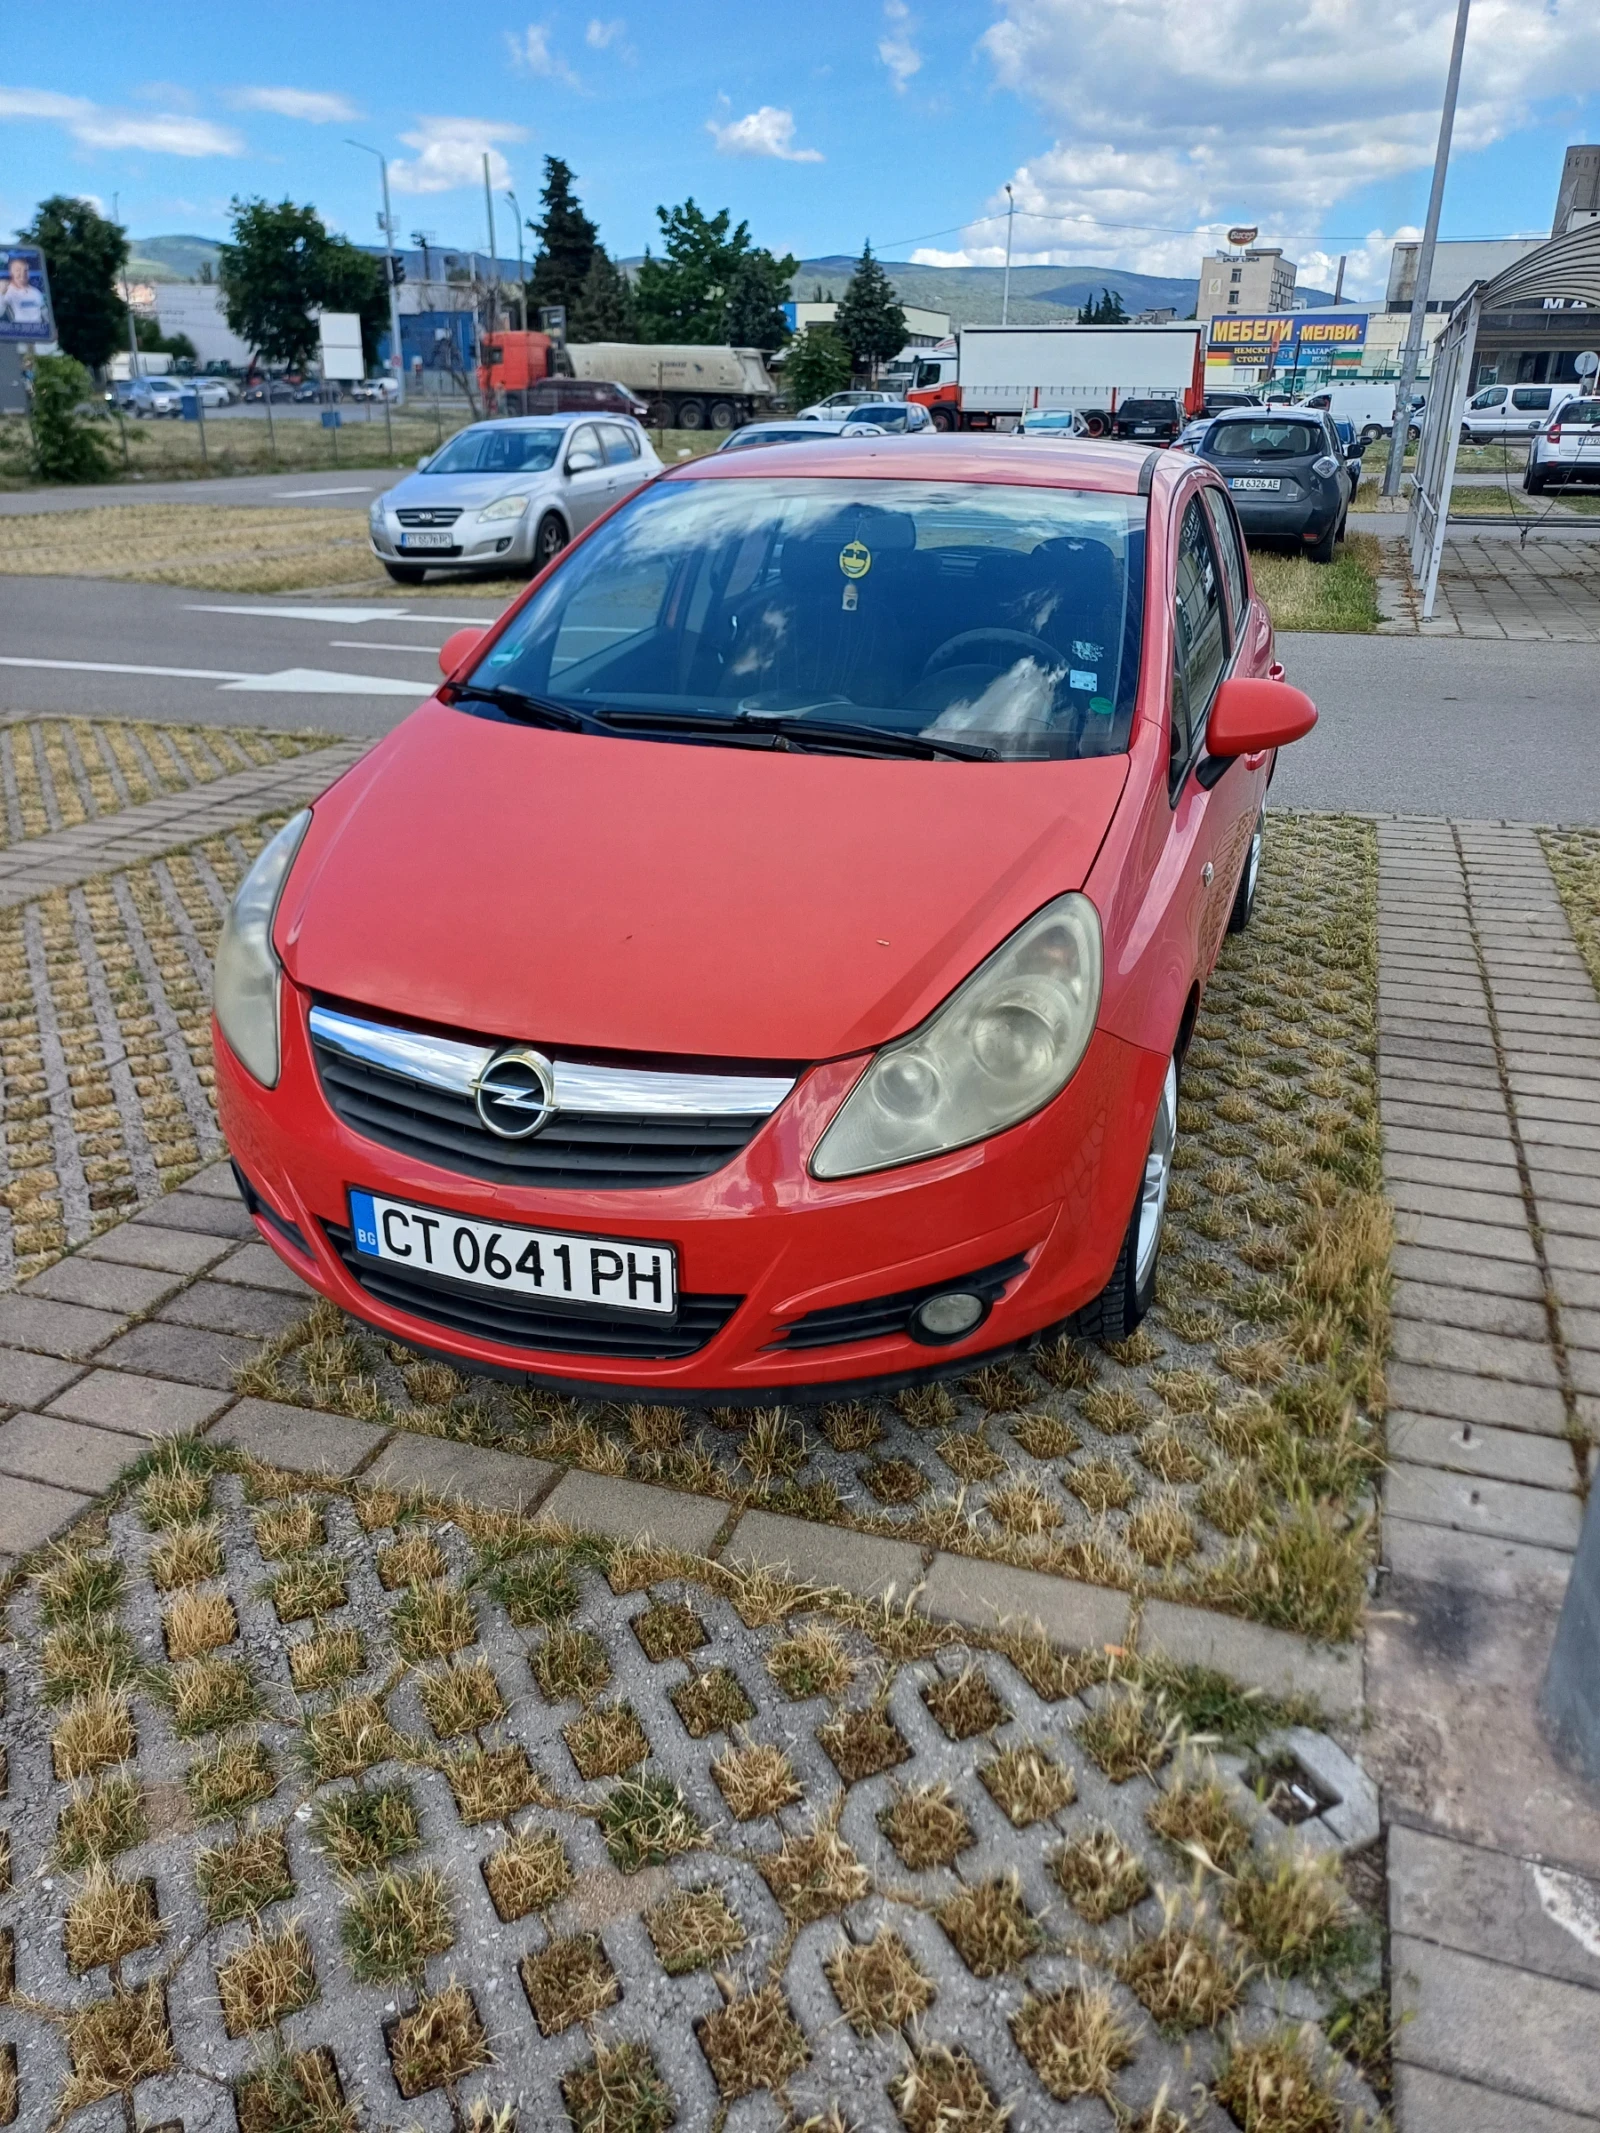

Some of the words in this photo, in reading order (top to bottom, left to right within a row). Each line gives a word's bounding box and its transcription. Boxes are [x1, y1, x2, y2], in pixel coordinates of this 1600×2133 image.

[1212, 319, 1294, 342] МЕБЕЛИ
[1301, 324, 1359, 341] МЕЛВИ
[1234, 347, 1271, 355] НЕМСКИ
[1233, 479, 1245, 488] EA
[1245, 479, 1267, 488] 6326
[1267, 479, 1279, 489] AE
[357, 1228, 376, 1247] BG
[382, 1208, 439, 1264] CT
[453, 1226, 572, 1292] 0641
[590, 1247, 662, 1304] PH
